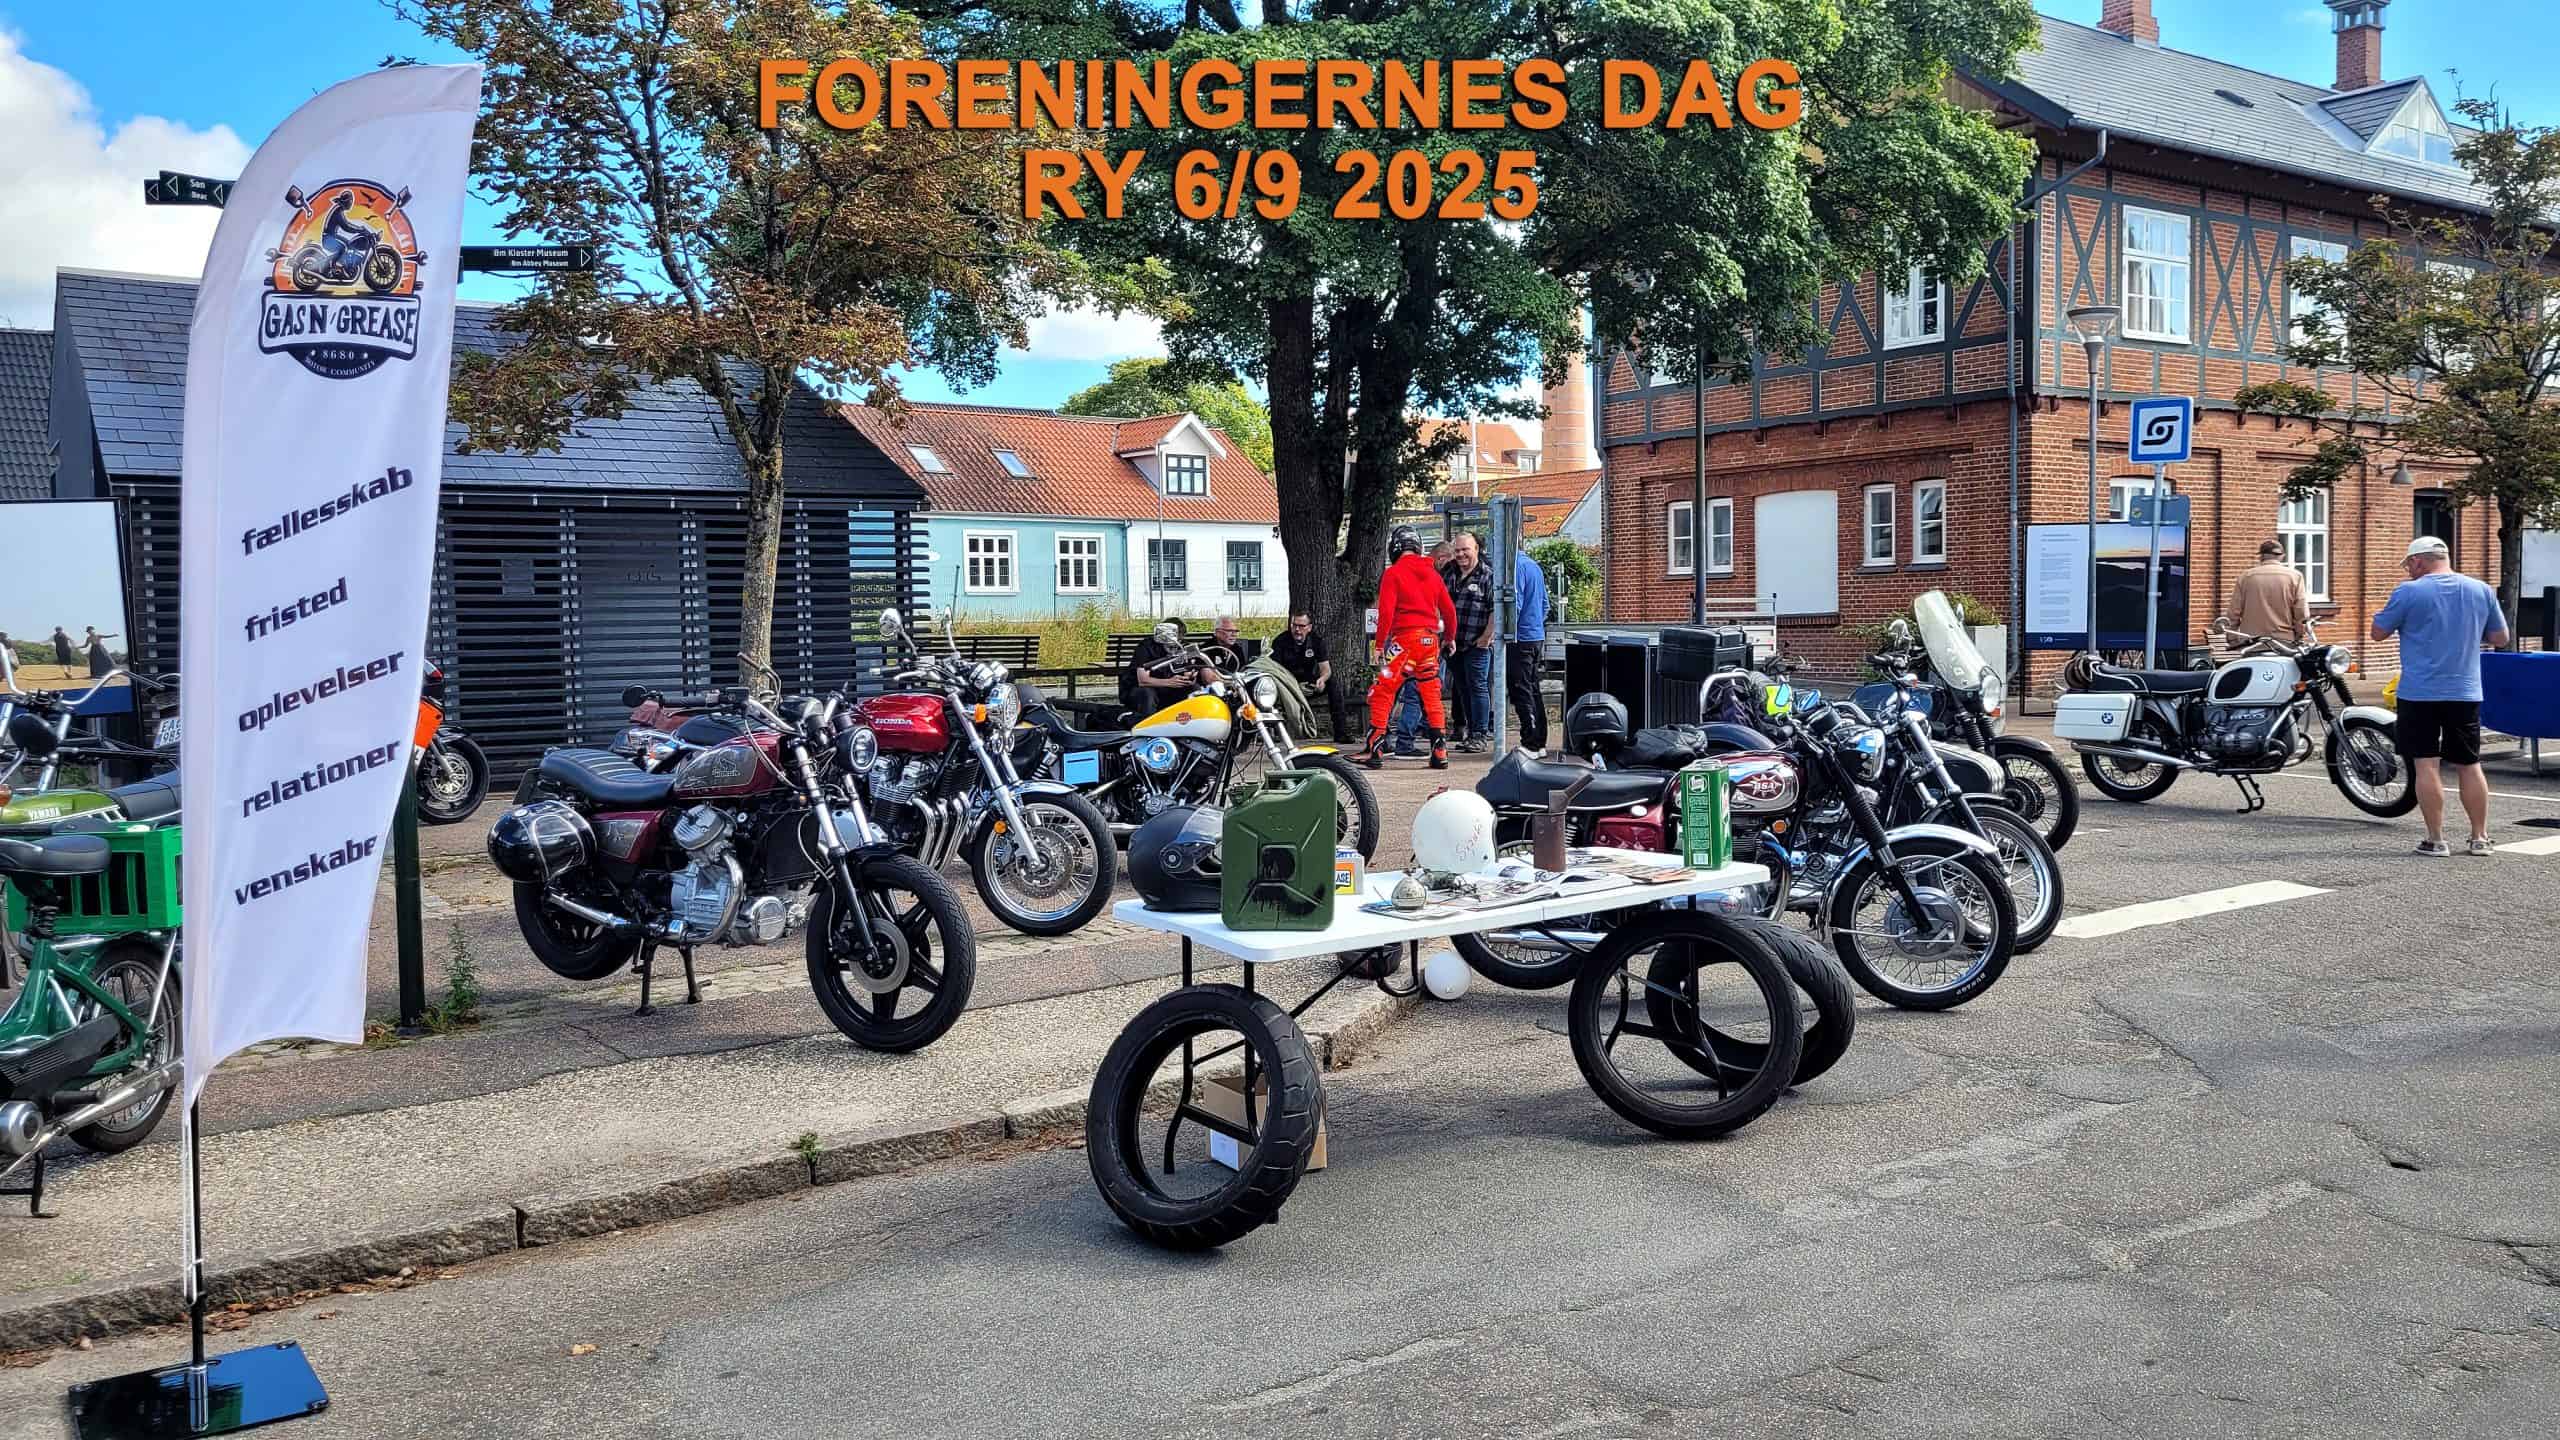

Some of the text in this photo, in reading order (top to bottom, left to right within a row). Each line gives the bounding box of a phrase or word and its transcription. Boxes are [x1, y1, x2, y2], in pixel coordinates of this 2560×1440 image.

[508, 247, 535, 257] Kloster
[537, 248, 569, 257] Museum
[543, 259, 569, 267] Museum
[264, 304, 306, 339] GAS
[336, 304, 417, 345] GREASE
[322, 350, 355, 360] 8680
[330, 358, 377, 377] COMMUNITY
[241, 466, 413, 556] fællesskab
[244, 576, 349, 642] fristed
[238, 651, 405, 732] oplevelser
[874, 717, 913, 725] HONDA
[243, 740, 401, 818] relationer
[235, 835, 378, 905] venskabe
